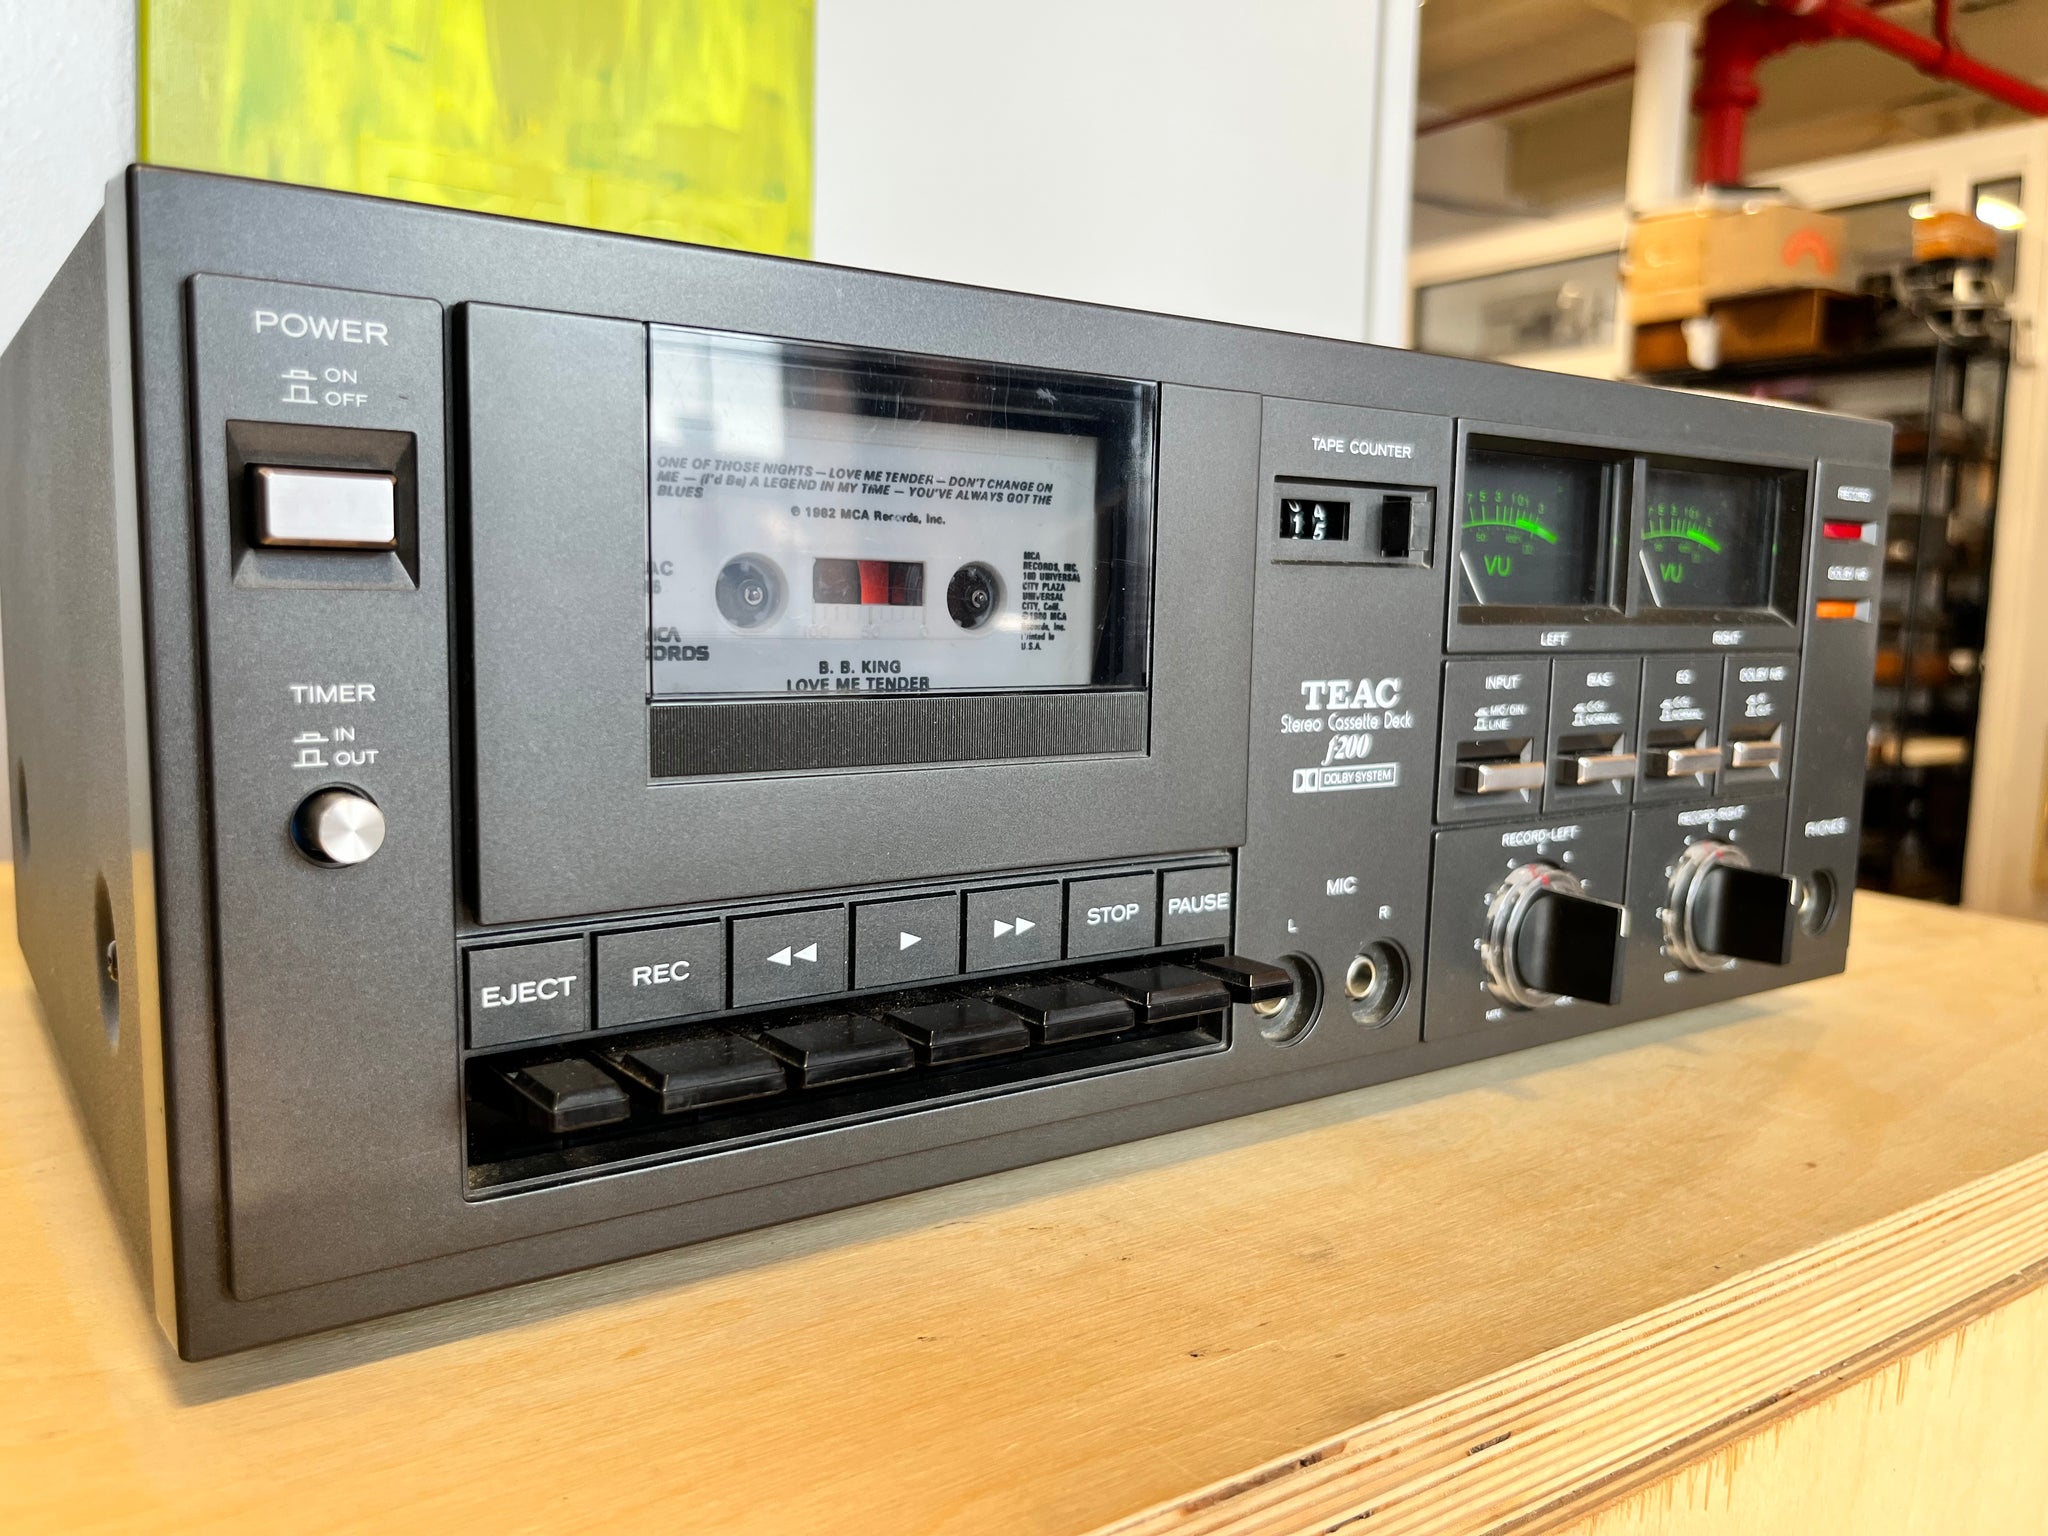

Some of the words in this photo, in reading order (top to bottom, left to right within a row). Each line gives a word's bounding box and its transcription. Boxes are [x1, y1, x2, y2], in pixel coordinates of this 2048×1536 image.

[255, 310, 389, 346] POWER
[325, 368, 357, 384] ON
[325, 391, 368, 407] OFF
[1311, 437, 1345, 453] TAPE
[1349, 441, 1412, 459] COUNTER
[657, 456, 688, 469] ONE
[692, 458, 711, 470] OF
[715, 459, 760, 474] THOSE
[763, 463, 813, 477] NIGHTS
[829, 467, 863, 481] LOVE
[864, 470, 882, 483] ME
[886, 471, 934, 485] TENDER
[949, 476, 985, 489] DON'T
[987, 479, 1034, 492] CHANGE
[1036, 482, 1054, 494] ON
[657, 471, 680, 483] ME
[750, 476, 760, 487] A
[763, 477, 817, 491] LEGEND
[820, 481, 835, 492] IN
[837, 482, 859, 494] MY
[862, 484, 891, 496] TIME
[909, 487, 952, 500] YOU'VE
[956, 489, 1004, 503] ALWAYS
[1007, 493, 1030, 505] GOT
[1033, 494, 1052, 506] THE
[657, 484, 704, 499] BLUES
[805, 506, 836, 519] 1982
[840, 508, 869, 521] MCA
[926, 513, 946, 525] Inc.
[1023, 551, 1040, 560] MCA
[1023, 561, 1060, 572] RECORDS,
[1484, 555, 1511, 577] VU
[1660, 562, 1684, 583] VU
[1039, 572, 1080, 583] UNIVERSAL
[1022, 582, 1039, 591] CITY
[1042, 582, 1065, 591] PLAZA
[1022, 592, 1064, 602] UNIVERSAL
[1022, 601, 1040, 611] CITY,
[1050, 612, 1067, 621] MCA
[819, 661, 833, 674] B.
[841, 661, 855, 674] B.
[862, 660, 901, 674] KING
[787, 679, 829, 692] LOVE
[836, 678, 860, 691] ME
[866, 677, 929, 691] TENDER
[1485, 674, 1522, 690] INPUT
[290, 684, 376, 703] TIMER
[1300, 677, 1401, 710] TEAC
[1280, 713, 1323, 733] Stereo
[1327, 711, 1381, 731] Cassette
[1383, 709, 1414, 729] Deck
[335, 727, 355, 742] IN
[334, 749, 379, 766] OUT
[1323, 772, 1354, 786] DOLBY
[1354, 769, 1393, 784] SYSTEM
[1326, 876, 1358, 896] MIC
[1168, 892, 1230, 916] PAUSE
[1378, 905, 1392, 920] R
[1086, 903, 1139, 926] STOP
[1287, 918, 1299, 934] L
[632, 960, 690, 987] REC
[481, 975, 577, 1008] EJECT
